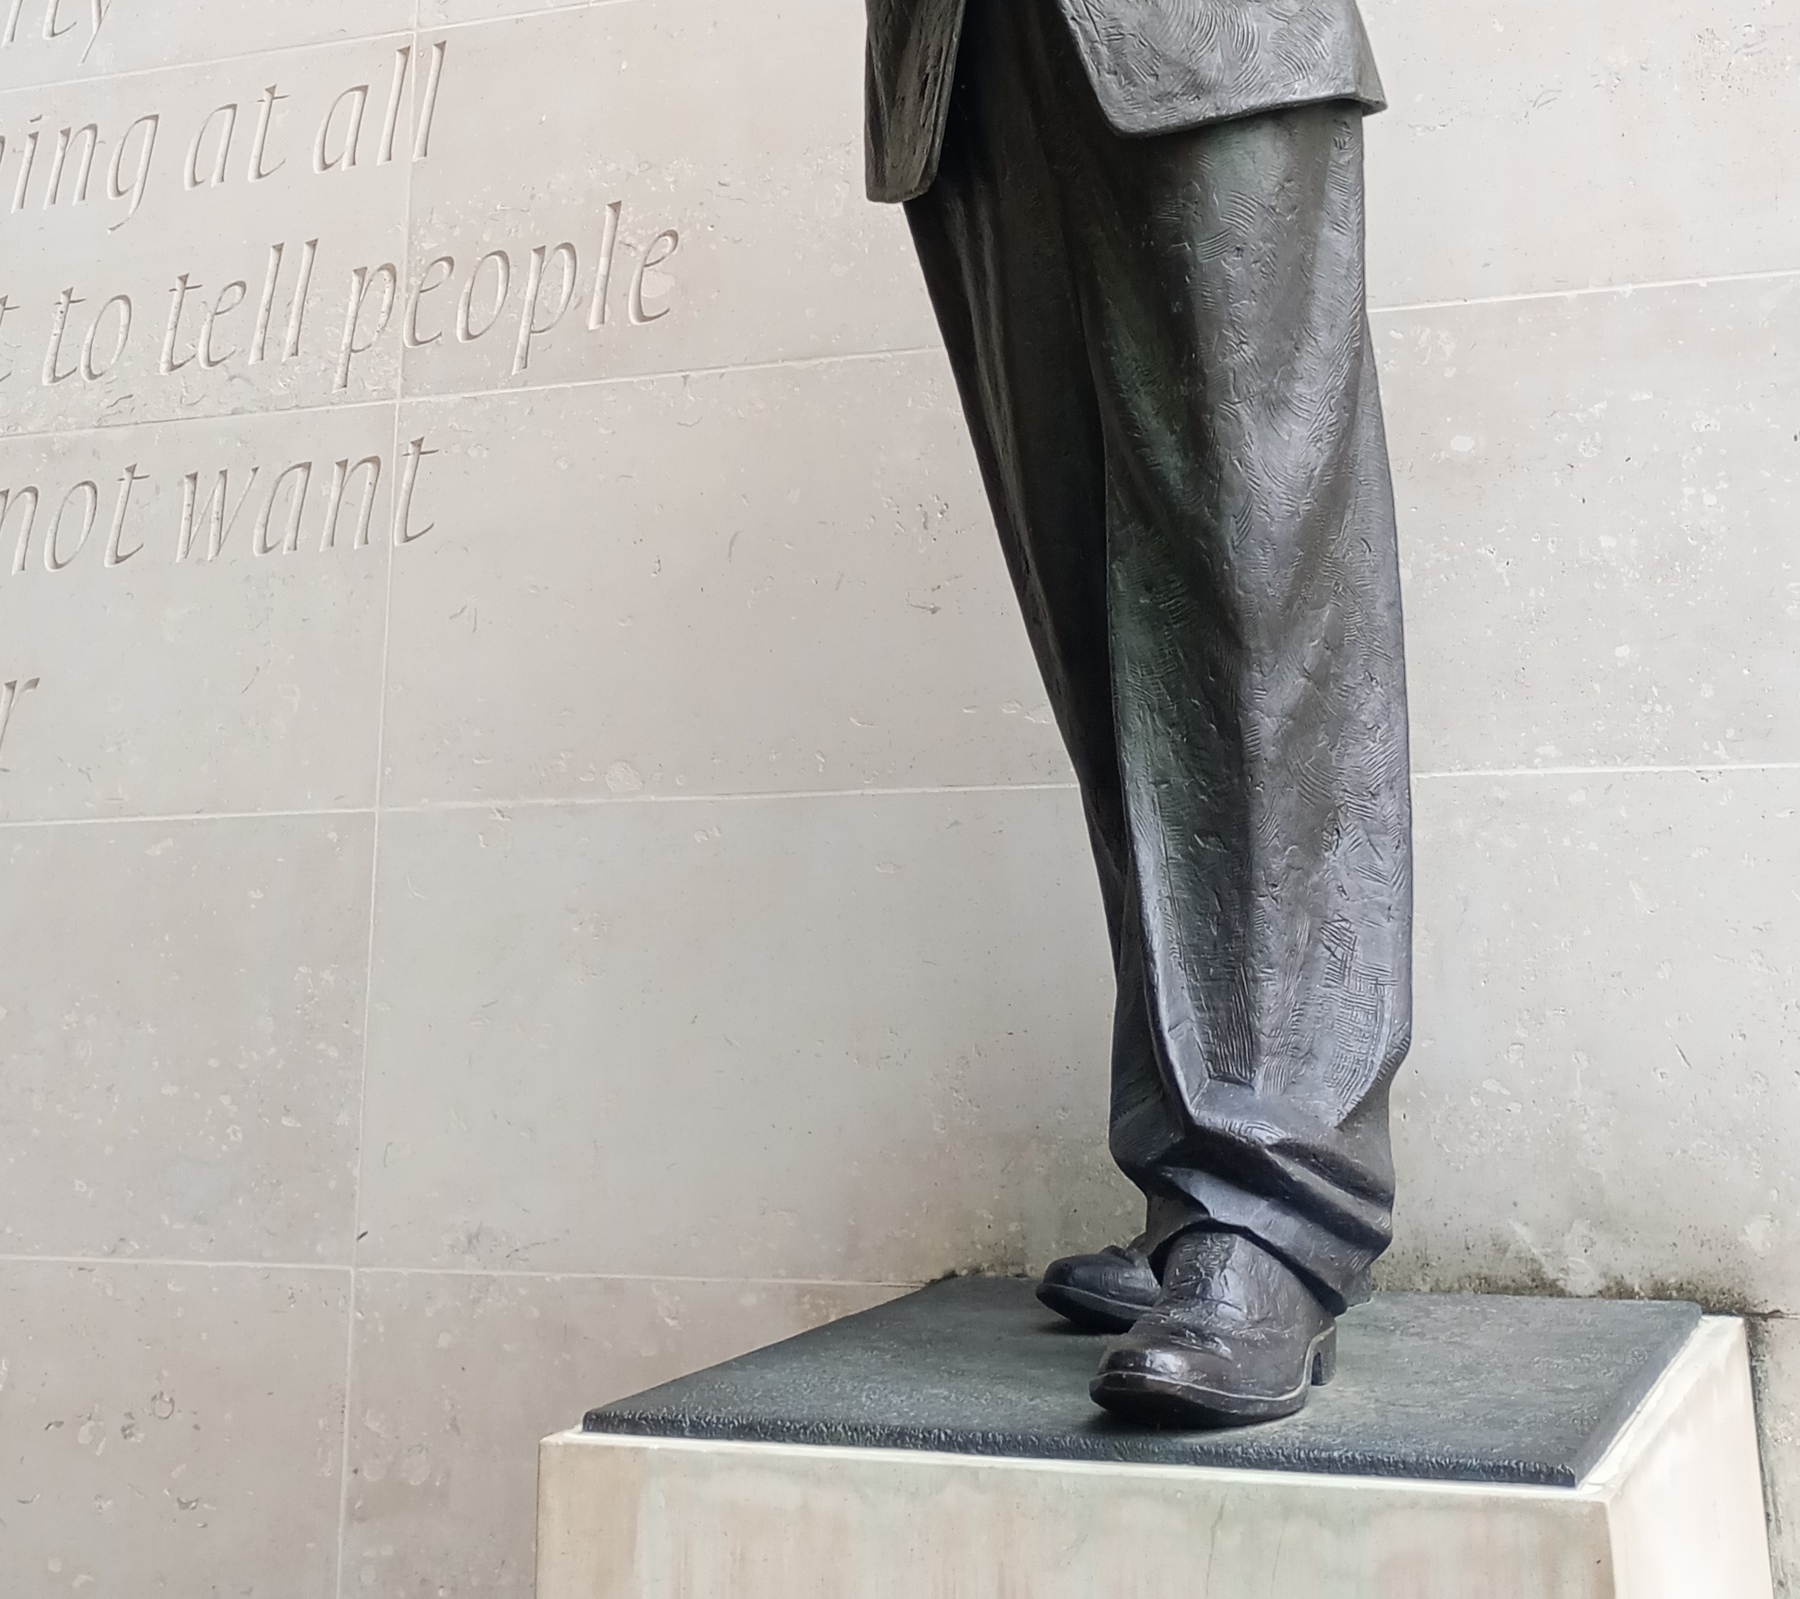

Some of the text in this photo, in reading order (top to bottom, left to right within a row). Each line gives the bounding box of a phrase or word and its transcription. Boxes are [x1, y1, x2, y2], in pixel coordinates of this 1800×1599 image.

[0, 40, 447, 234] ing at all
[42, 286, 132, 386] to
[159, 238, 319, 375] tell
[332, 200, 679, 394] people
[0, 435, 439, 576] not want
